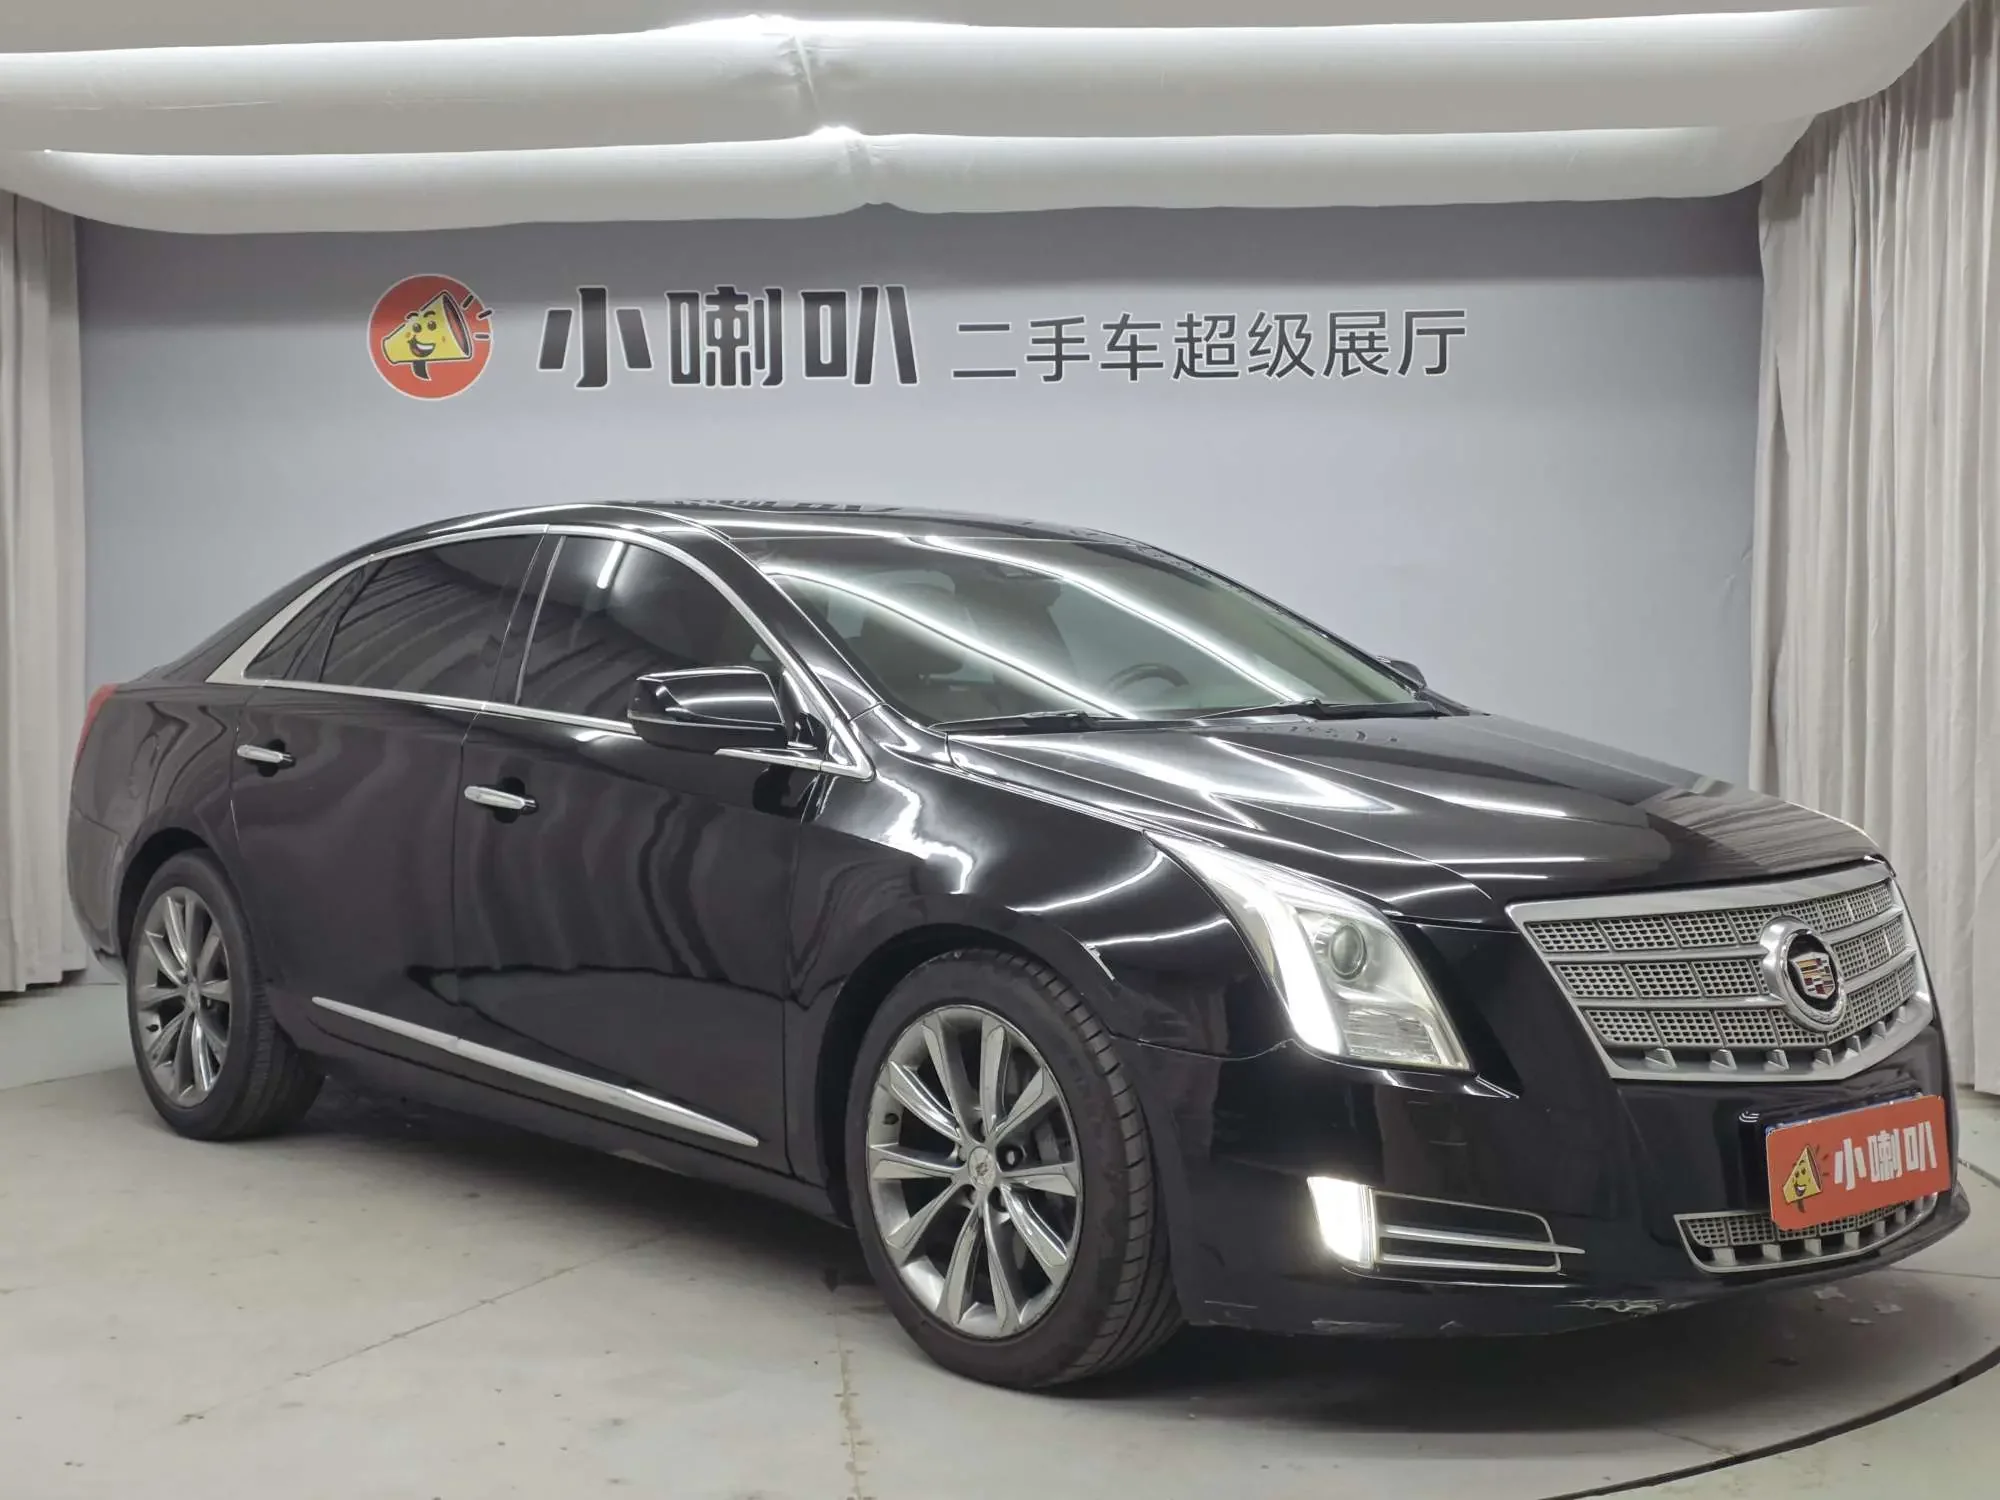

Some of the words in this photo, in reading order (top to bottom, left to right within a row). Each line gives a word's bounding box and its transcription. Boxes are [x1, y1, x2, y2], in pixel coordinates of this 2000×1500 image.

[537, 285, 918, 388] 小喇叭
[953, 309, 1466, 382] 二手车超级展厅
[1834, 1120, 1937, 1190] 小喇叭
